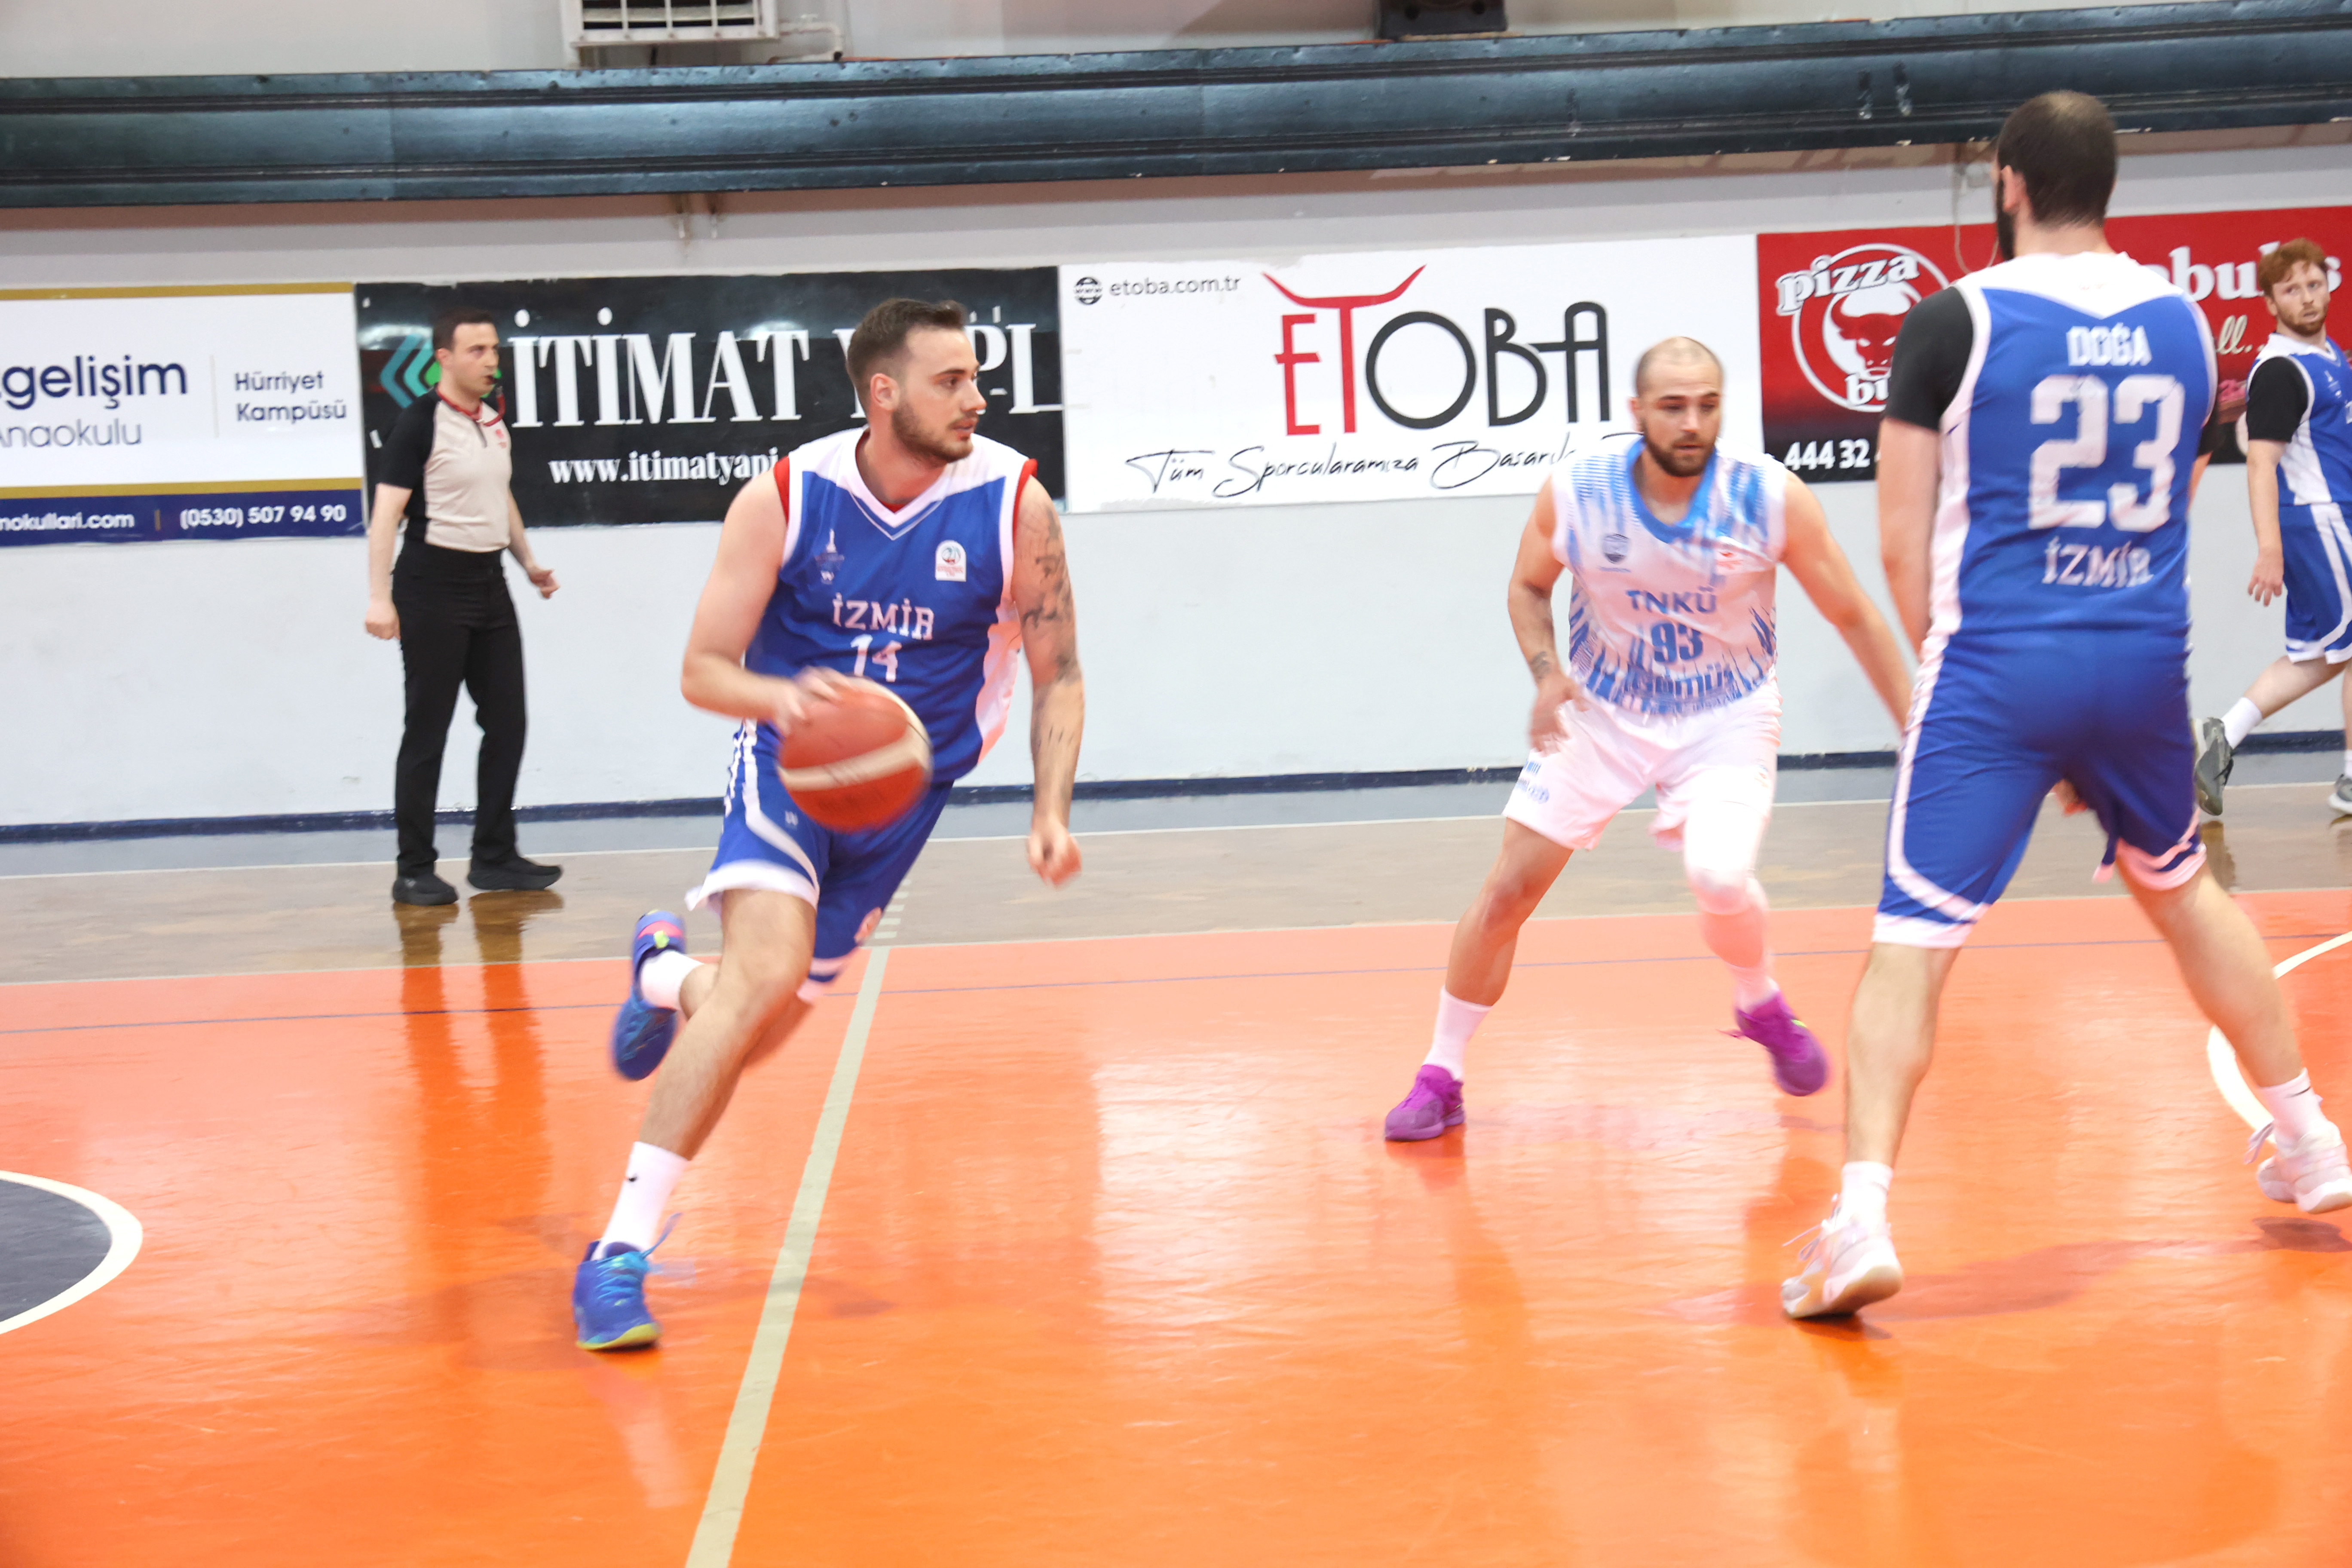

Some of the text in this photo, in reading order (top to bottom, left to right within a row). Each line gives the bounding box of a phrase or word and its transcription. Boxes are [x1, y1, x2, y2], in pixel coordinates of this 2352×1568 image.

[1109, 276, 1241, 296] etoba.com.tr
[1777, 255, 1920, 315] pizza
[507, 307, 809, 427] İTİMAT
[1262, 263, 1611, 436] ETOBA
[0, 354, 187, 410] gelişim
[234, 371, 324, 393] Hürriyet
[236, 399, 347, 424] Kampüsü
[1124, 449, 1215, 493] Tüm
[1839, 434, 1870, 468] 32
[2028, 373, 2186, 532] 23
[180, 504, 347, 530] (0530) 507 94 90
[2042, 536, 2154, 588] İZMİR
[832, 592, 934, 640] İZMİR
[1626, 585, 1717, 615] TNKÜ
[850, 634, 902, 683] 14
[1651, 622, 1703, 664] 93
